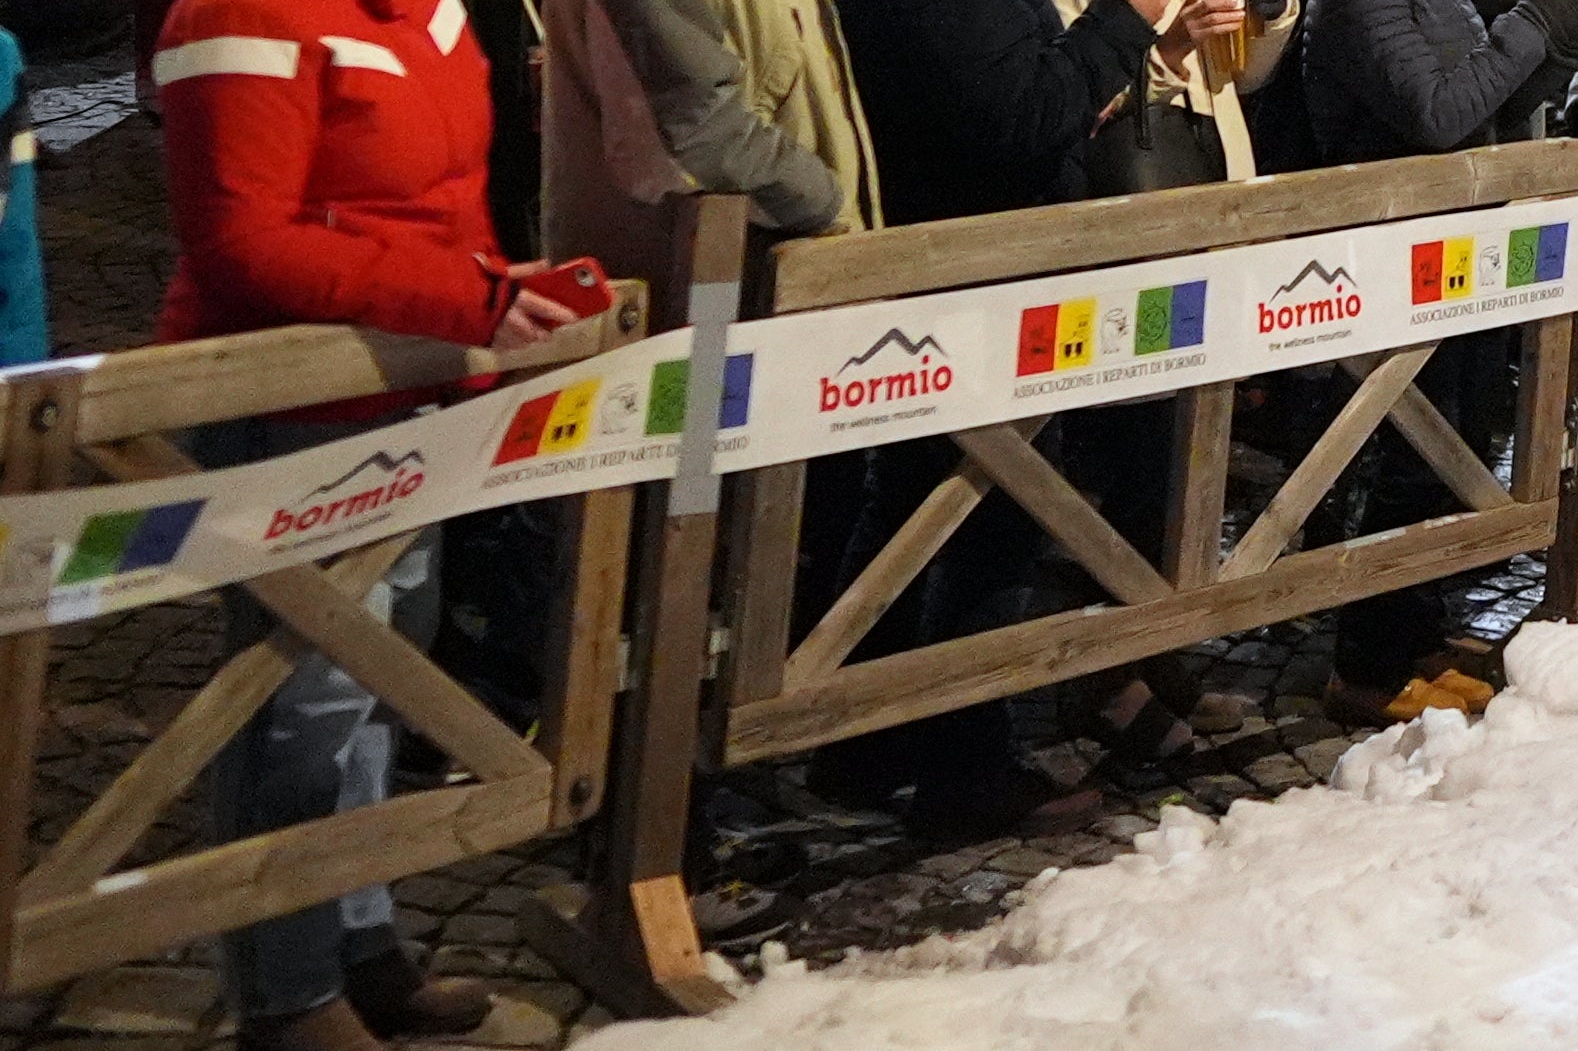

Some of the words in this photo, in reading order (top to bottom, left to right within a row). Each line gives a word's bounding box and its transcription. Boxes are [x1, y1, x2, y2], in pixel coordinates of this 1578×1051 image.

[1258, 284, 1362, 333] bormio
[1410, 302, 1474, 325] ASSOCIAZIONE
[1481, 293, 1517, 312] REPARTI
[1530, 286, 1564, 303] BORMIO
[818, 355, 953, 413] bormio
[1014, 374, 1095, 398] ASSOCIAZIONE
[1103, 363, 1147, 384] REPARTI
[1149, 361, 1161, 375] DI
[1164, 353, 1207, 371] BORMIO
[263, 467, 424, 540] bormio
